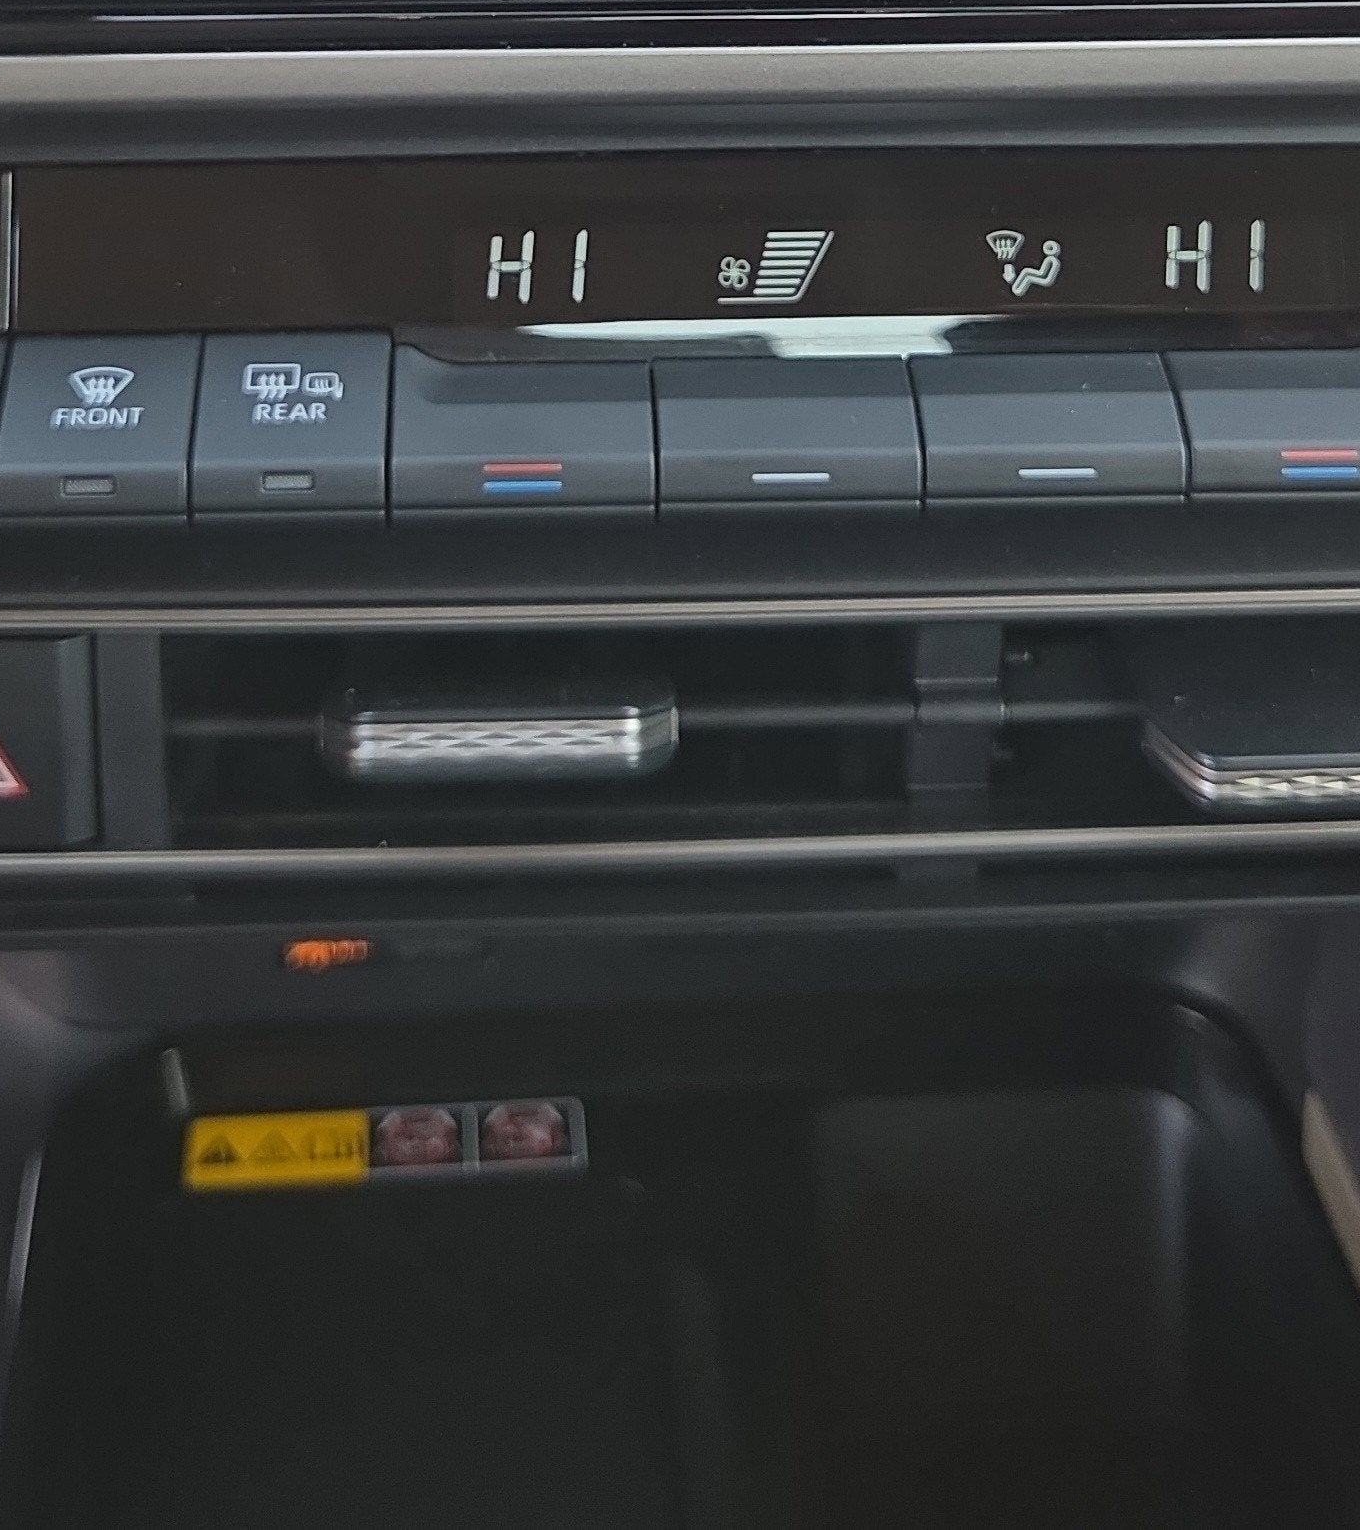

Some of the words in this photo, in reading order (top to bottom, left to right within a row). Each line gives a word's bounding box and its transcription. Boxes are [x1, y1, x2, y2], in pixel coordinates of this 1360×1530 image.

[487, 230, 587, 303] HI
[1166, 220, 1264, 293] HI
[51, 407, 144, 427] FRONT
[253, 403, 326, 423] REAR
